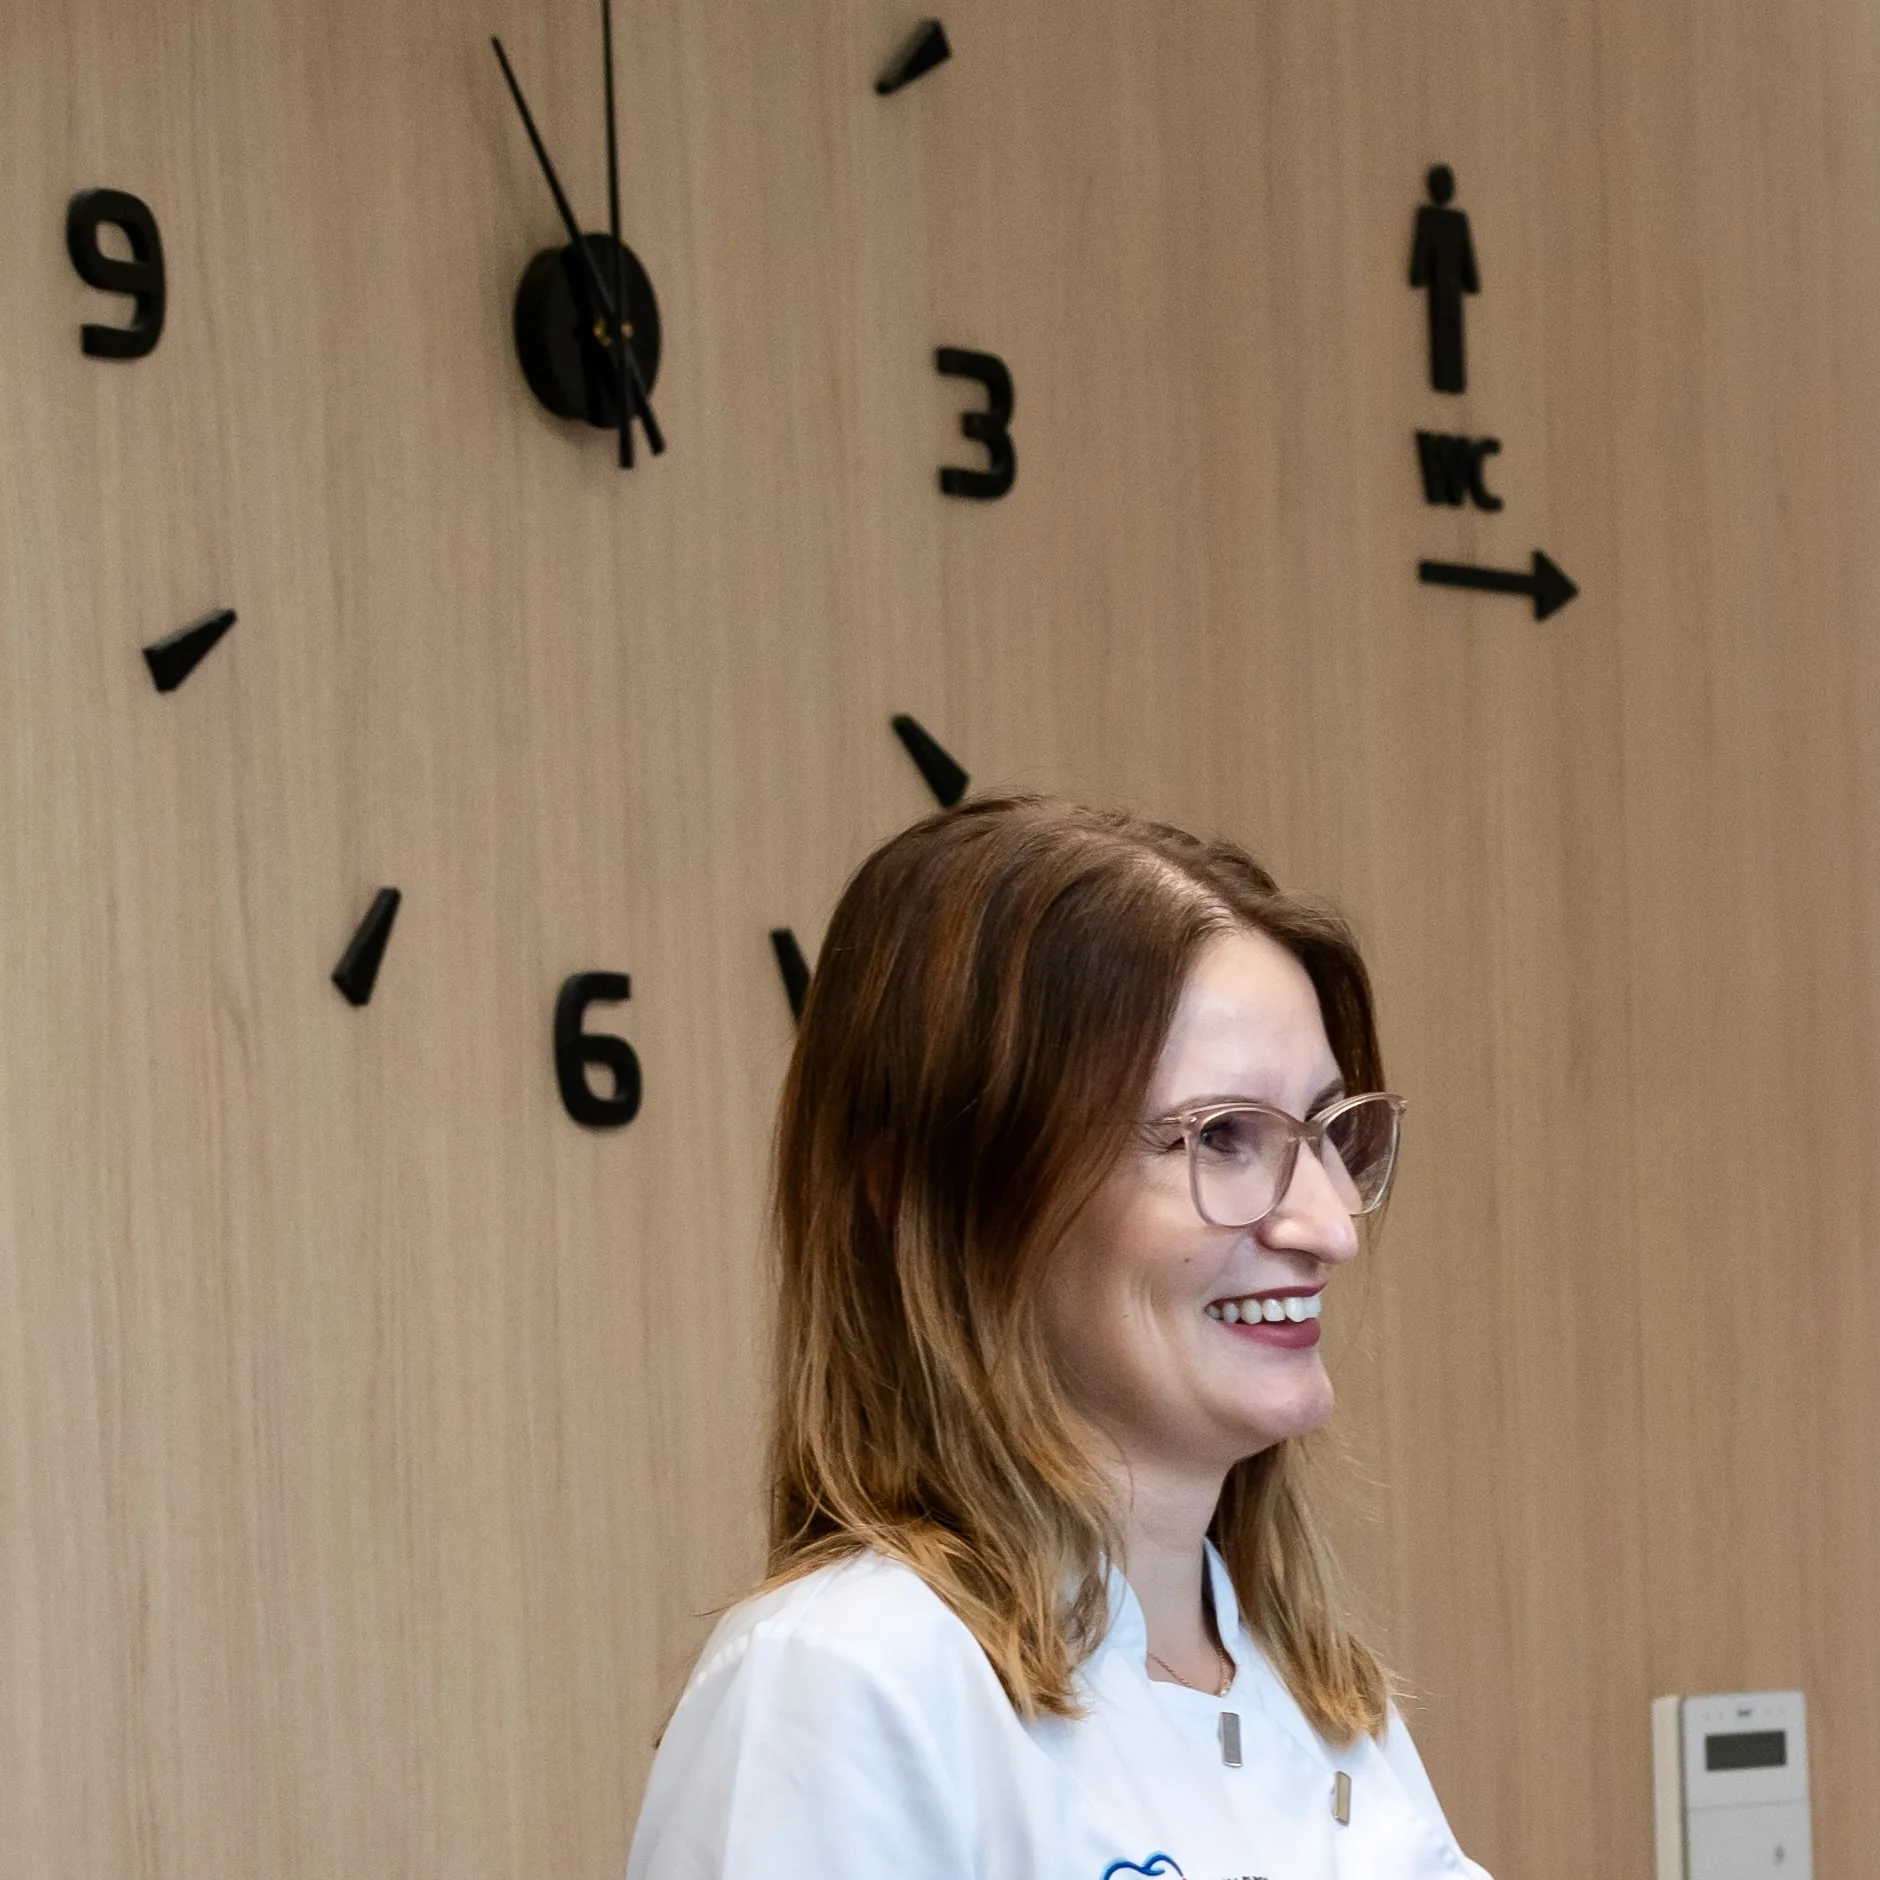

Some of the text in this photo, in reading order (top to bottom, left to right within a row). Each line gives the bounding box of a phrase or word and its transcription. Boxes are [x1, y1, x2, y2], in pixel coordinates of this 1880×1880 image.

[67, 187, 166, 360] 9
[936, 347, 1017, 500] 3
[1416, 431, 1505, 513] WC
[554, 971, 644, 1129] 6
